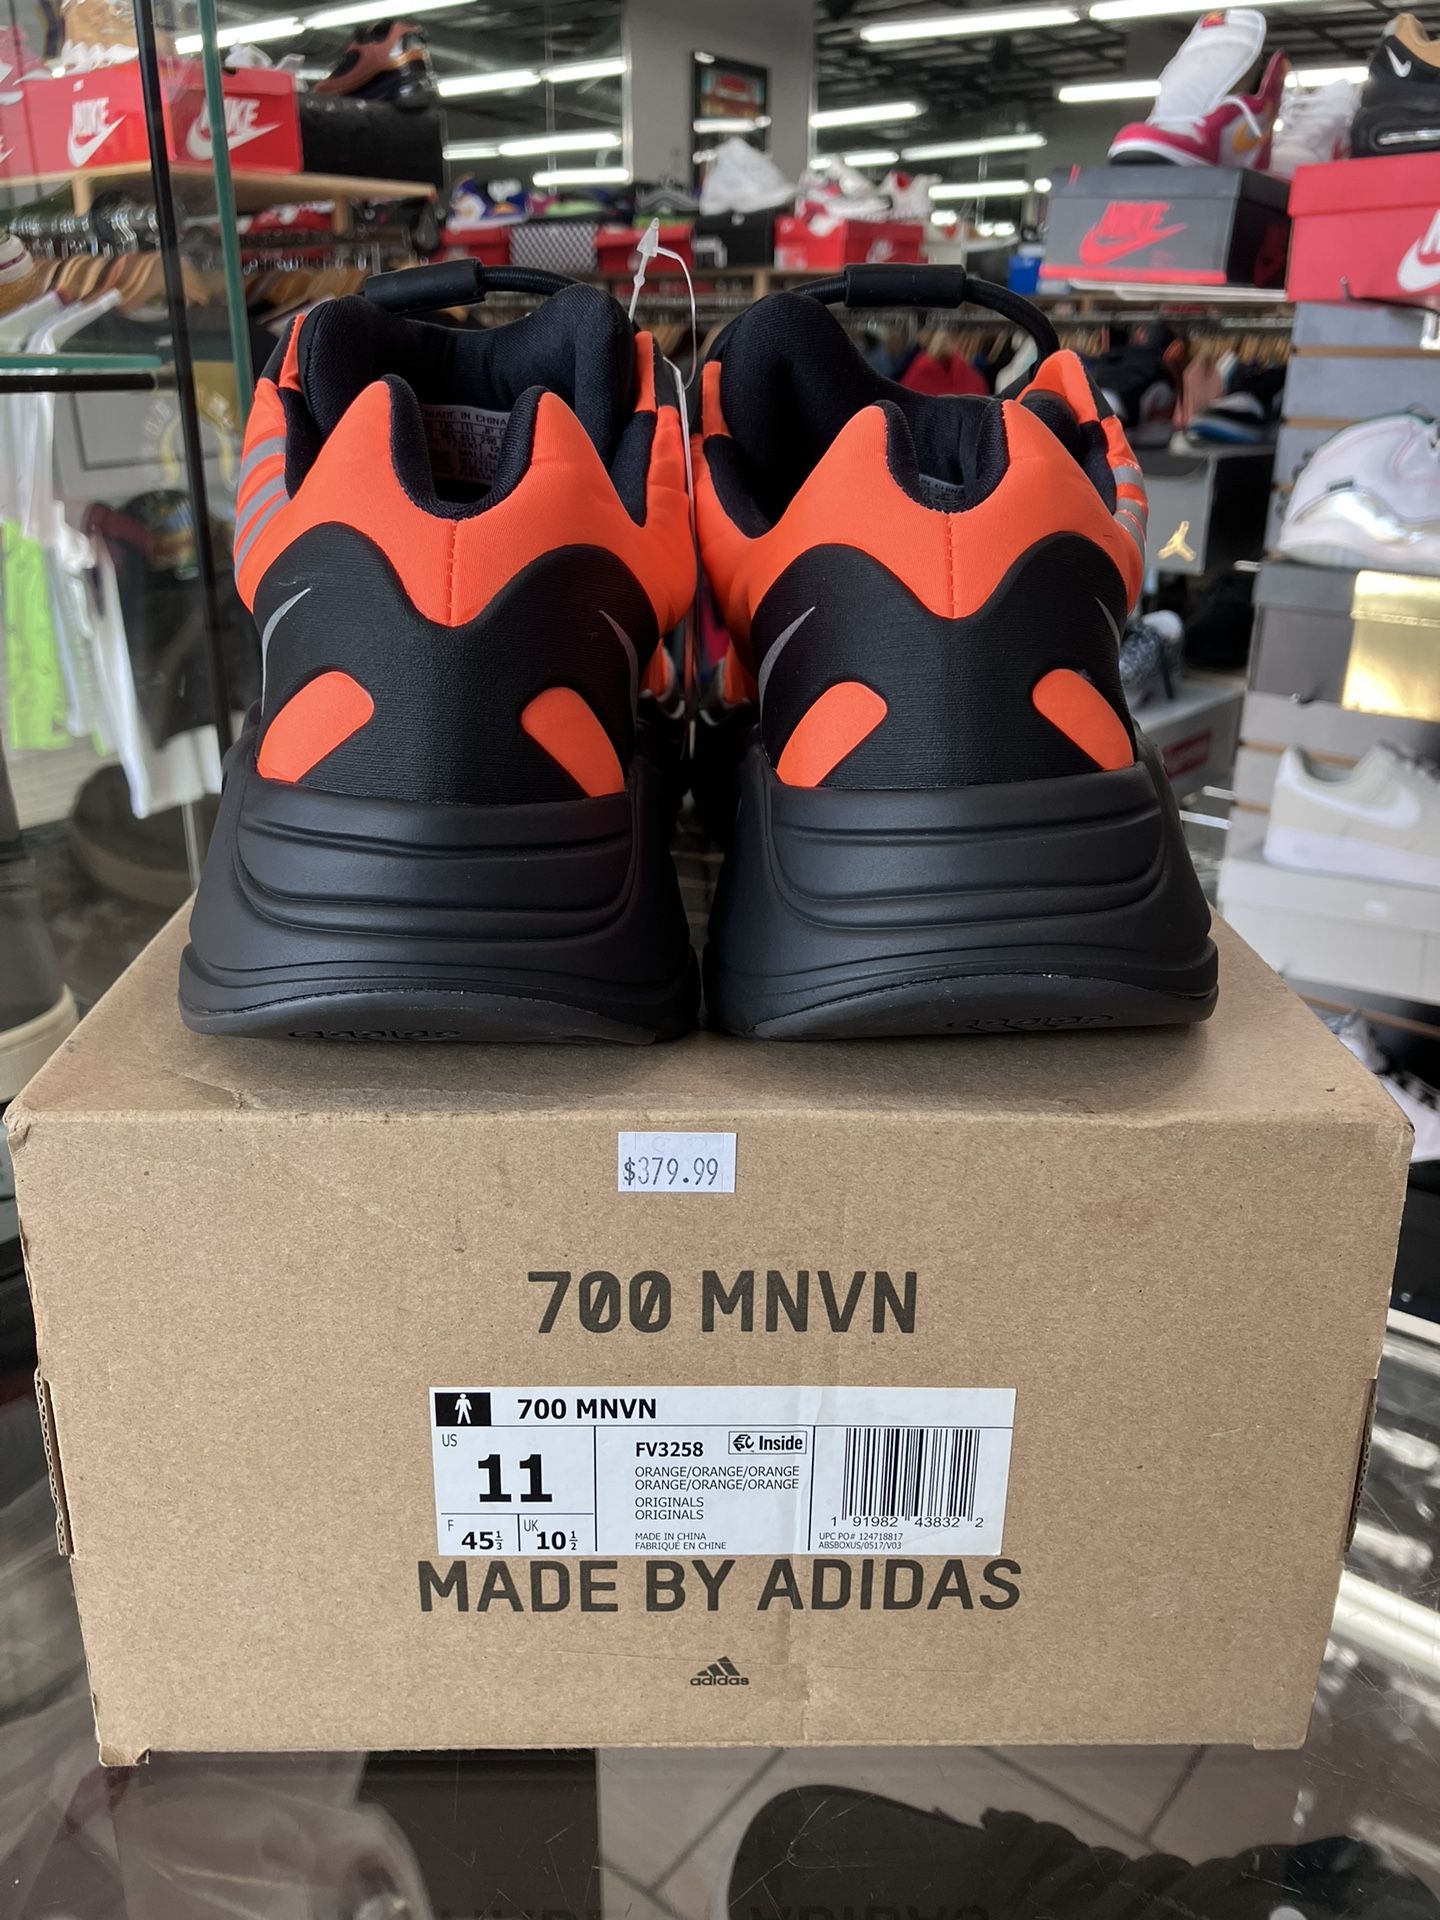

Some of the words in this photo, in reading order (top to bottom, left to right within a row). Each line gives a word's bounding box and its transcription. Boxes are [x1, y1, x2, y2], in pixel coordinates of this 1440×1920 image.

[475, 414, 507, 426] CHINA
[624, 1157, 719, 1186] $379.99
[527, 1270, 671, 1334] 700
[701, 1270, 917, 1334] MNVN
[517, 1399, 567, 1419] 700
[576, 1399, 657, 1419] MNVN
[441, 1434, 457, 1447] US
[759, 1435, 803, 1451] Inside
[635, 1442, 704, 1457] FV3258
[635, 1465, 799, 1478] ORANGE/ORANGE/ORANGE
[477, 1454, 552, 1503] 11
[635, 1479, 799, 1491] ORANGE/ORANGE/ORANGE
[635, 1496, 704, 1508] ORIGINALS
[635, 1509, 704, 1520] ORIGINALS
[447, 1520, 454, 1531] F
[523, 1520, 539, 1531] UK
[831, 1516, 837, 1526] 1
[852, 1516, 899, 1527] 91982
[914, 1516, 960, 1528] 43832
[975, 1517, 984, 1528] 2
[635, 1532, 661, 1541] MADE
[664, 1532, 674, 1541] IN
[677, 1532, 706, 1541] CHINA
[819, 1532, 836, 1541] UPC
[838, 1532, 855, 1541] PO#
[859, 1532, 903, 1541] 124718817
[683, 1542, 696, 1550] EN
[698, 1542, 727, 1550] CHINE
[417, 1559, 619, 1612] MADE
[645, 1559, 735, 1612] BY
[757, 1558, 1022, 1611] ADIDAS
[690, 1674, 750, 1686] adidas
